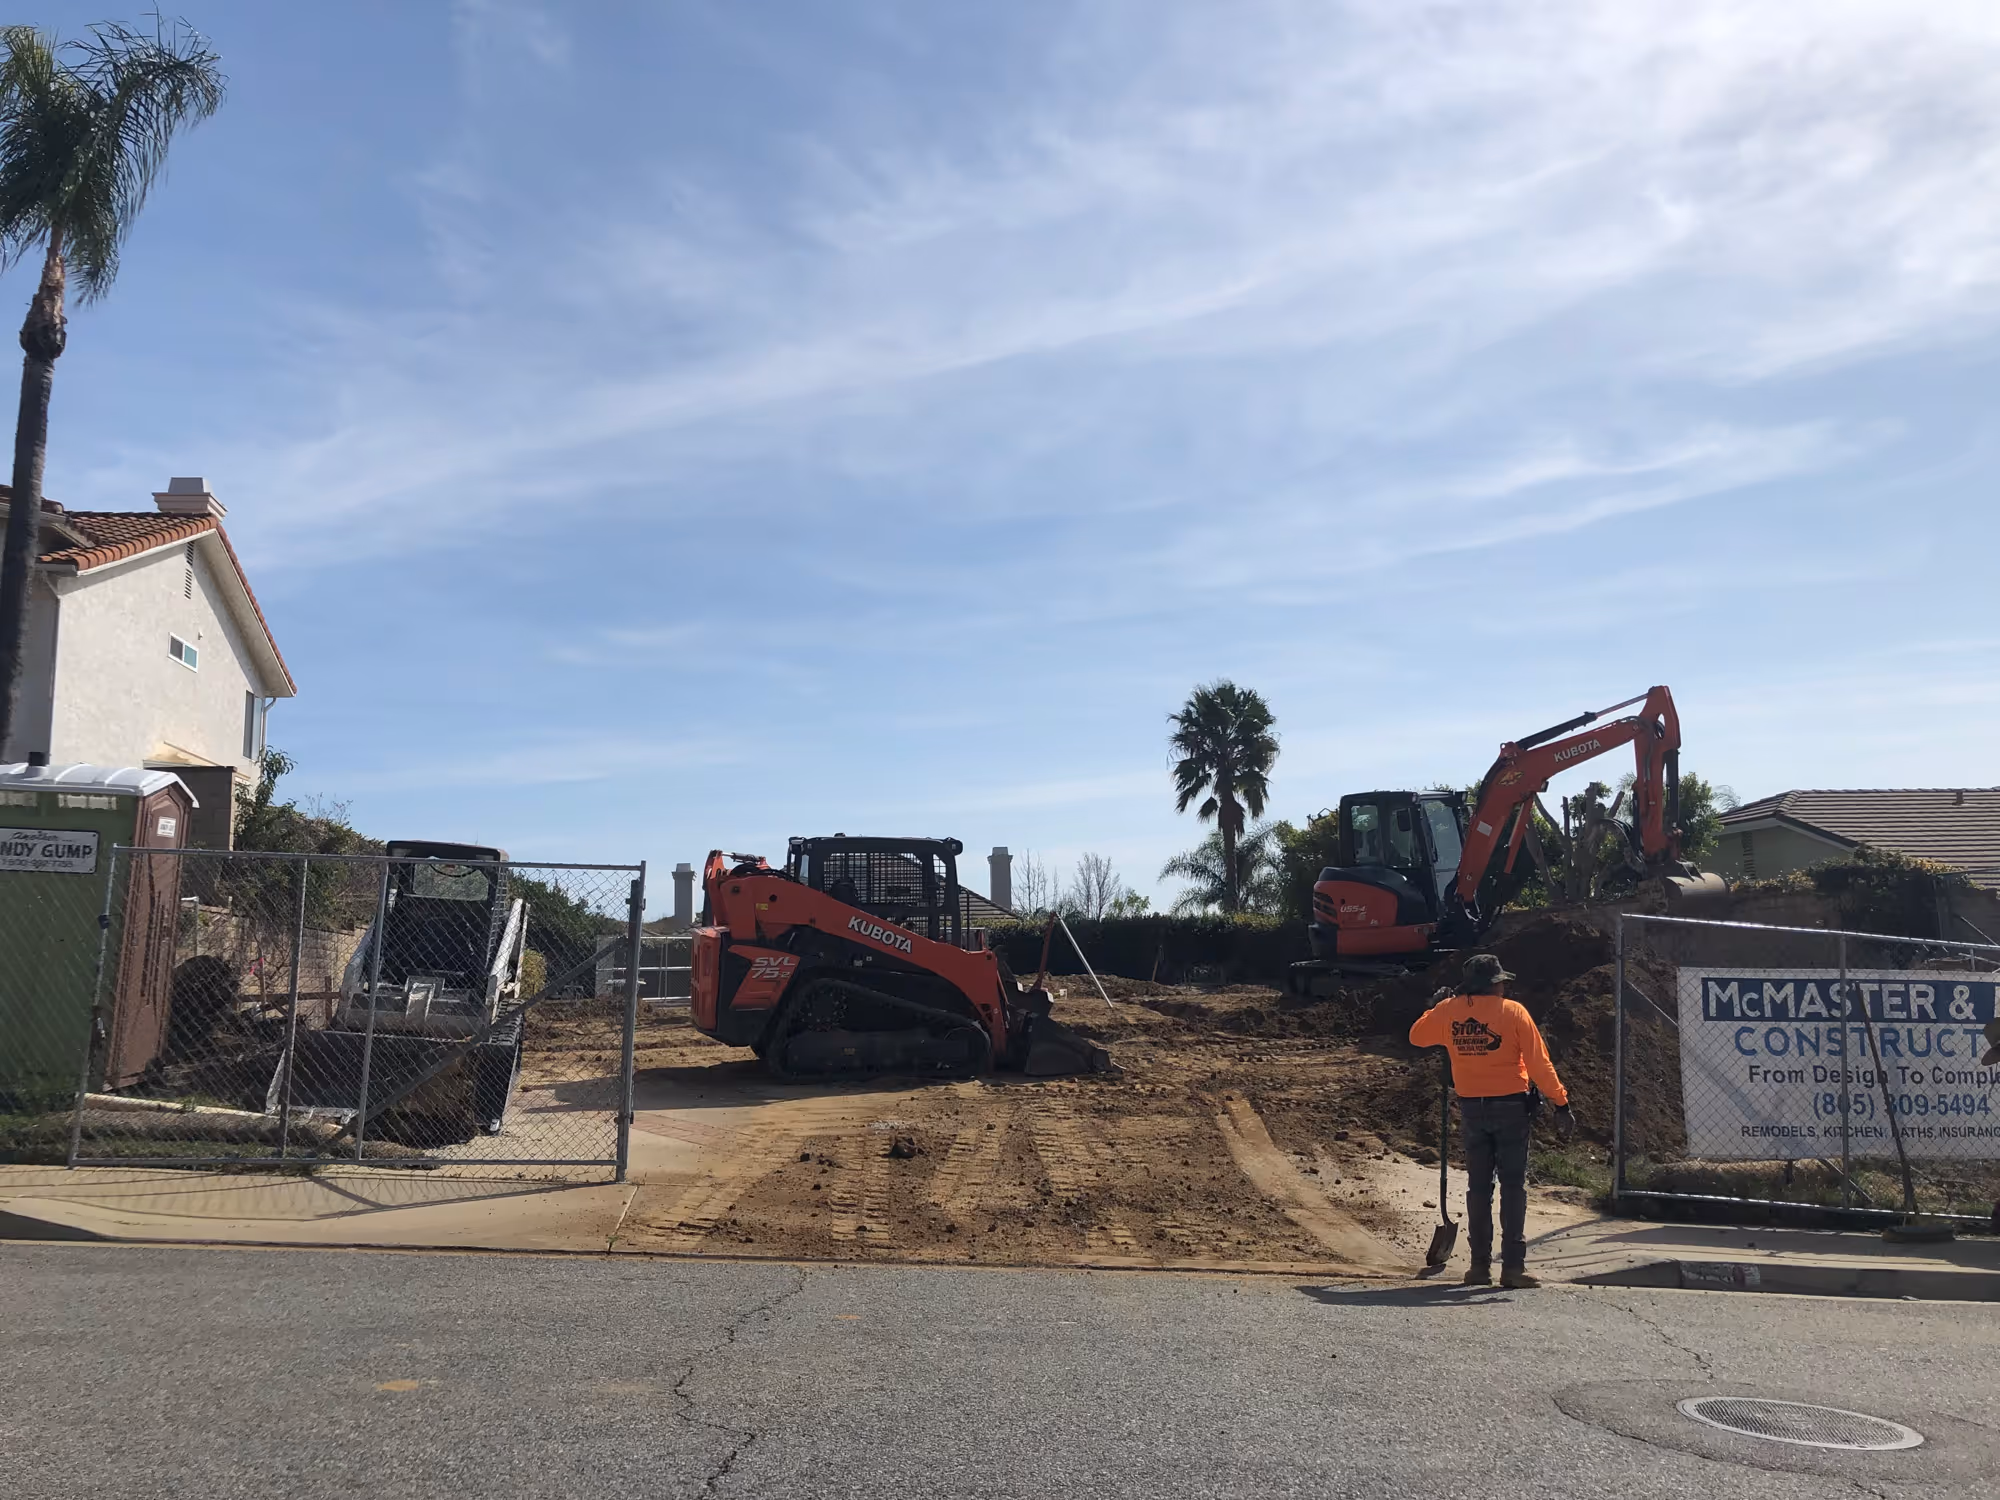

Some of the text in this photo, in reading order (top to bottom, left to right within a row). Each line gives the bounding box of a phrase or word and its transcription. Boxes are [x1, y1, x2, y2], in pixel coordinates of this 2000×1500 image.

[1554, 739, 1602, 762] KUBOTA
[41, 844, 93, 859] GUMP
[848, 916, 913, 953] KUBOTA
[753, 956, 796, 967] SVL
[1707, 981, 1937, 1020] McMASTER
[1949, 984, 1977, 1021] &
[1451, 1020, 1489, 1036] STOCK
[1748, 1065, 1805, 1084] From
[1812, 1065, 1889, 1088] Design
[1896, 1066, 1924, 1084] To
[1741, 1126, 1820, 1140] REMODELS,
[1892, 1127, 1937, 1140] ATHS,
